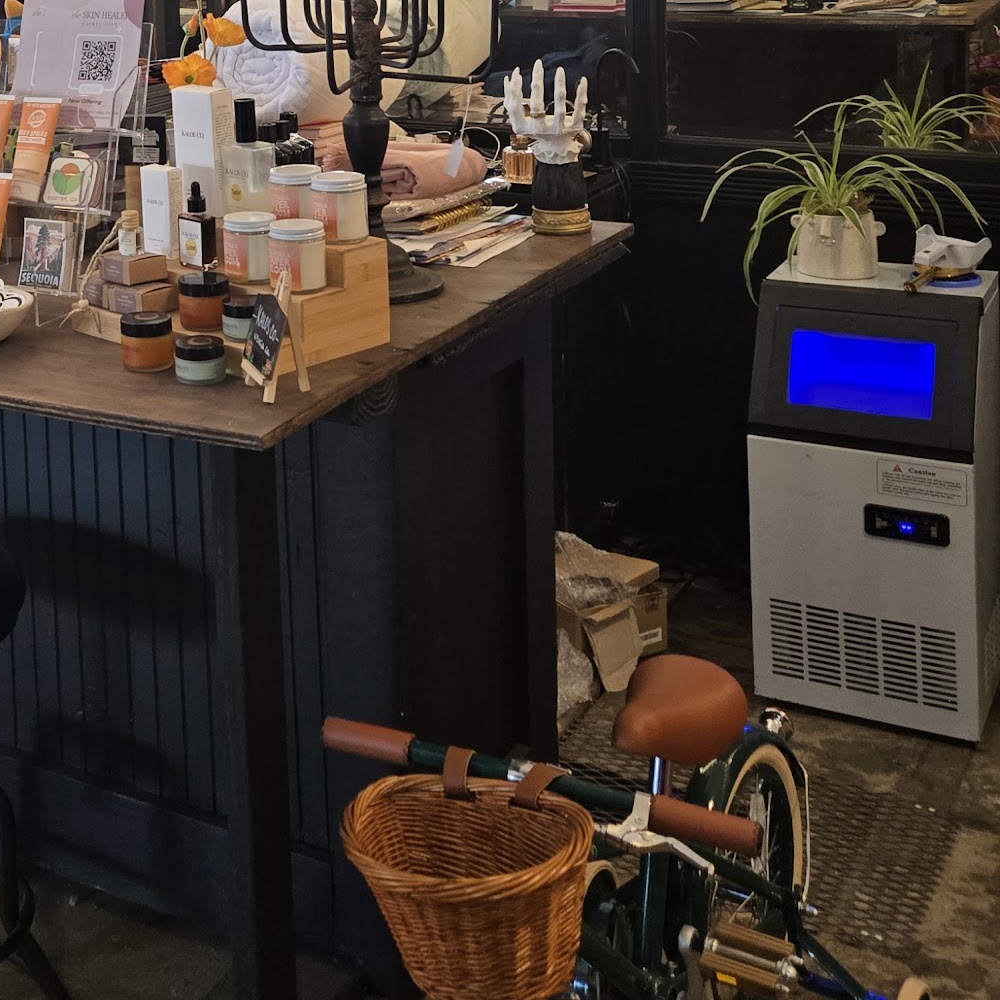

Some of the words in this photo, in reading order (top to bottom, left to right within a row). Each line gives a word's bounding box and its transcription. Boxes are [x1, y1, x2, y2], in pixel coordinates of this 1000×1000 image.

[82, 10, 100, 20] SKIN
[21, 272, 59, 287] SEQUOIA
[909, 467, 936, 477] Caution
